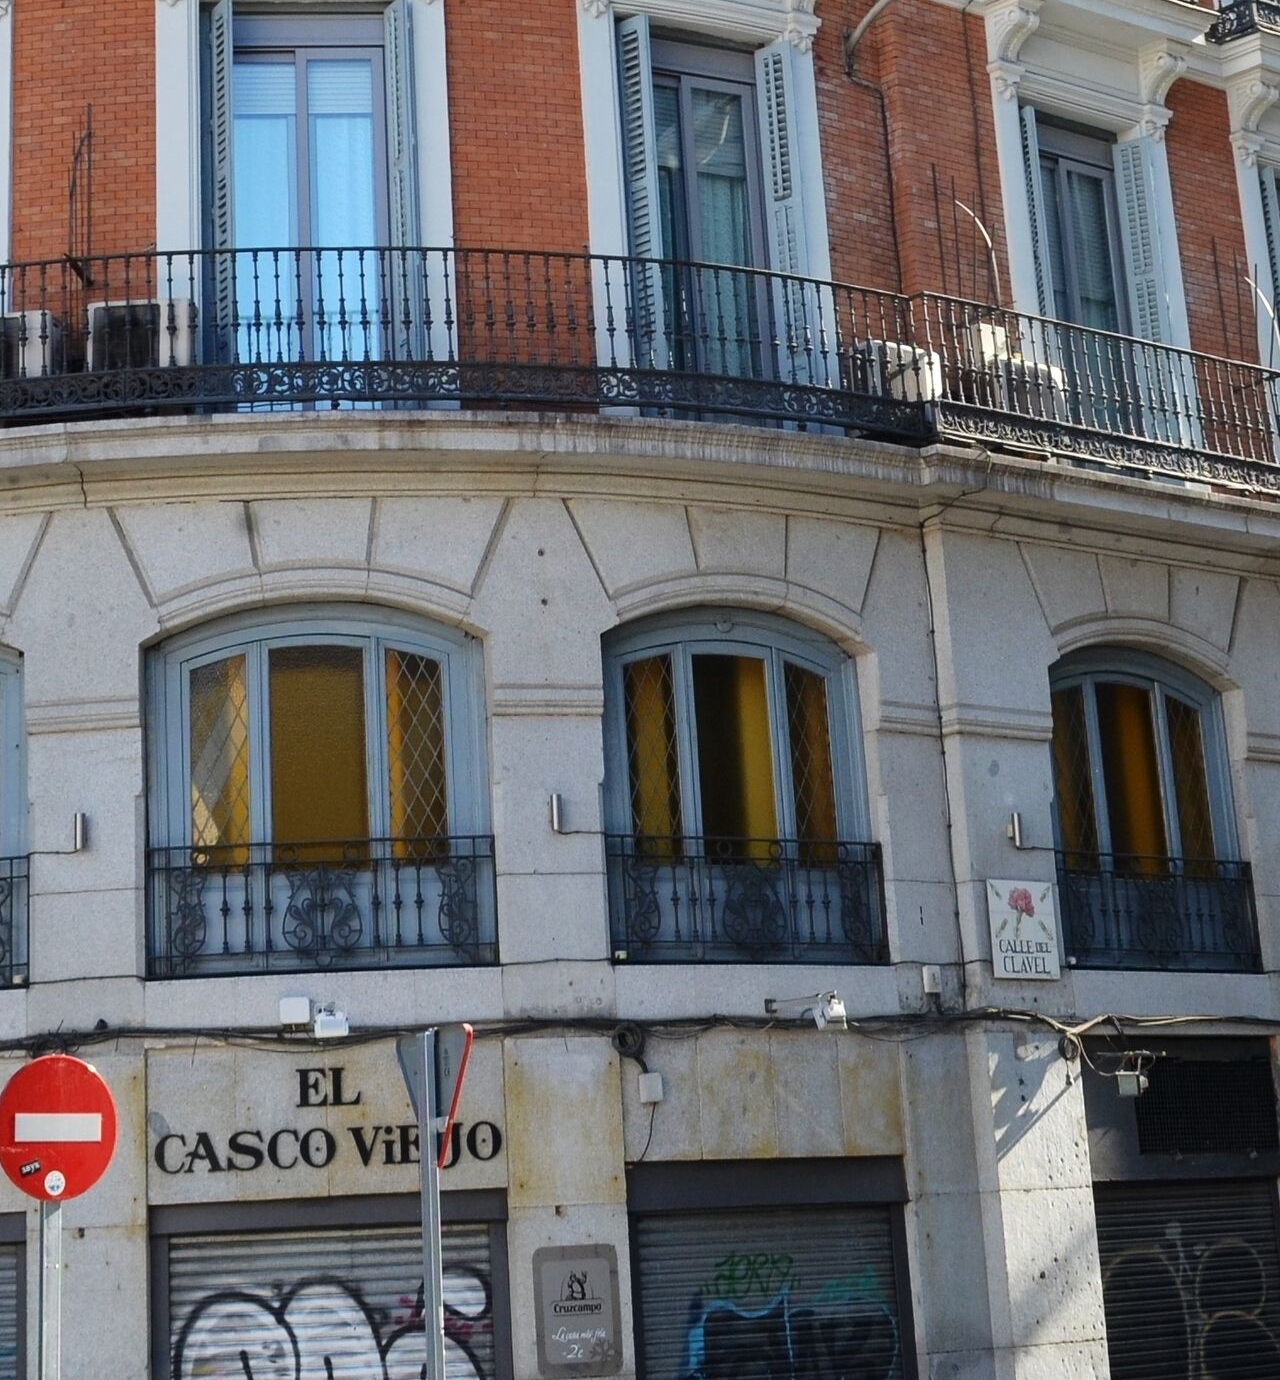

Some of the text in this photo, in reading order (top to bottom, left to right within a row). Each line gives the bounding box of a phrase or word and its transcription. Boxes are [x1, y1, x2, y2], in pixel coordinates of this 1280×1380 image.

[998, 939, 1052, 955] CALLE DEL
[1002, 956, 1052, 975] CLAVEL
[294, 1066, 362, 1109] EL
[153, 1126, 338, 1176] CASCO
[554, 1302, 602, 1314] Cruzcampo
